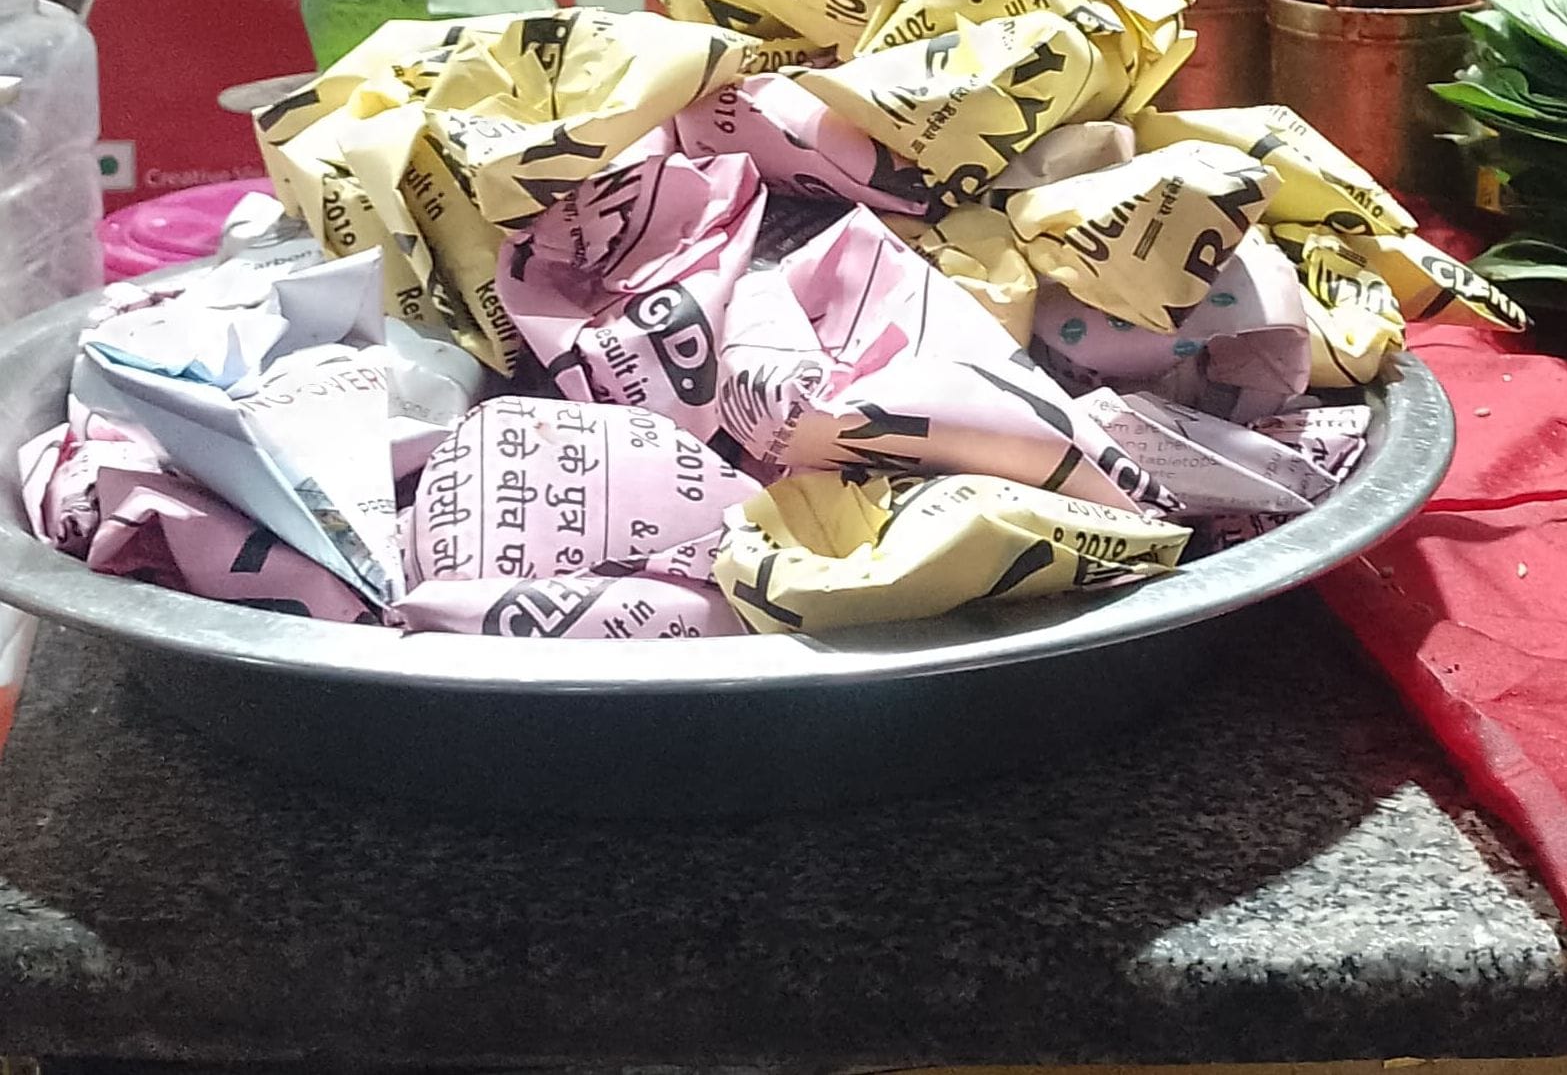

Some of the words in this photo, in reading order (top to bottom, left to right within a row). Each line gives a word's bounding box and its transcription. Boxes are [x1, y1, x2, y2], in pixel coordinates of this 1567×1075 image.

[323, 190, 357, 247] 2019
[497, 428, 540, 460] के
[558, 444, 600, 476] के
[676, 439, 704, 503] 2019
[496, 469, 539, 532] बीच
[545, 483, 586, 537] पुत्र
